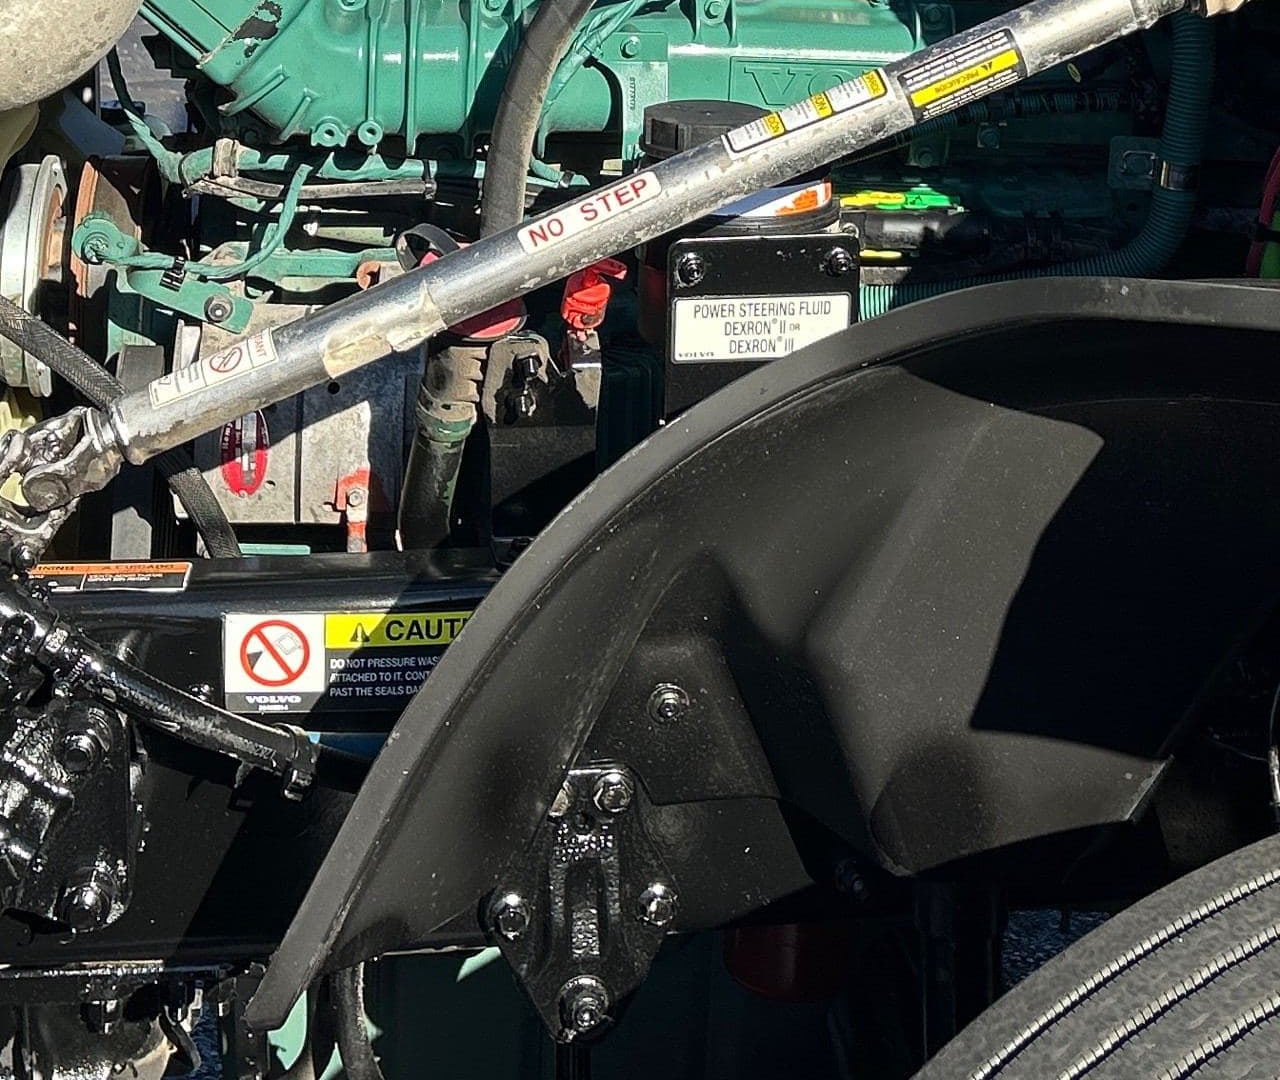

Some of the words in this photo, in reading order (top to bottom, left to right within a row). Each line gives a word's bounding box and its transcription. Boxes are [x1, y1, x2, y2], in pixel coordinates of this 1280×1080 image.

[528, 218, 564, 247] NO
[579, 178, 647, 221] STEP
[694, 303, 735, 319] POWER
[739, 302, 795, 317] STEERING
[799, 301, 831, 315] FLUID
[385, 618, 468, 641] CAUT
[330, 658, 345, 669] DO
[346, 658, 365, 669] NOT
[367, 657, 415, 668] PRESSURE
[418, 655, 441, 666] WAS
[329, 672, 377, 683] ATTACHED
[379, 672, 391, 682] TO
[405, 670, 431, 680] CONT
[330, 687, 353, 697] PAST
[356, 687, 372, 696] THE
[374, 686, 404, 695] SEALS
[245, 695, 302, 703] VOLVO
